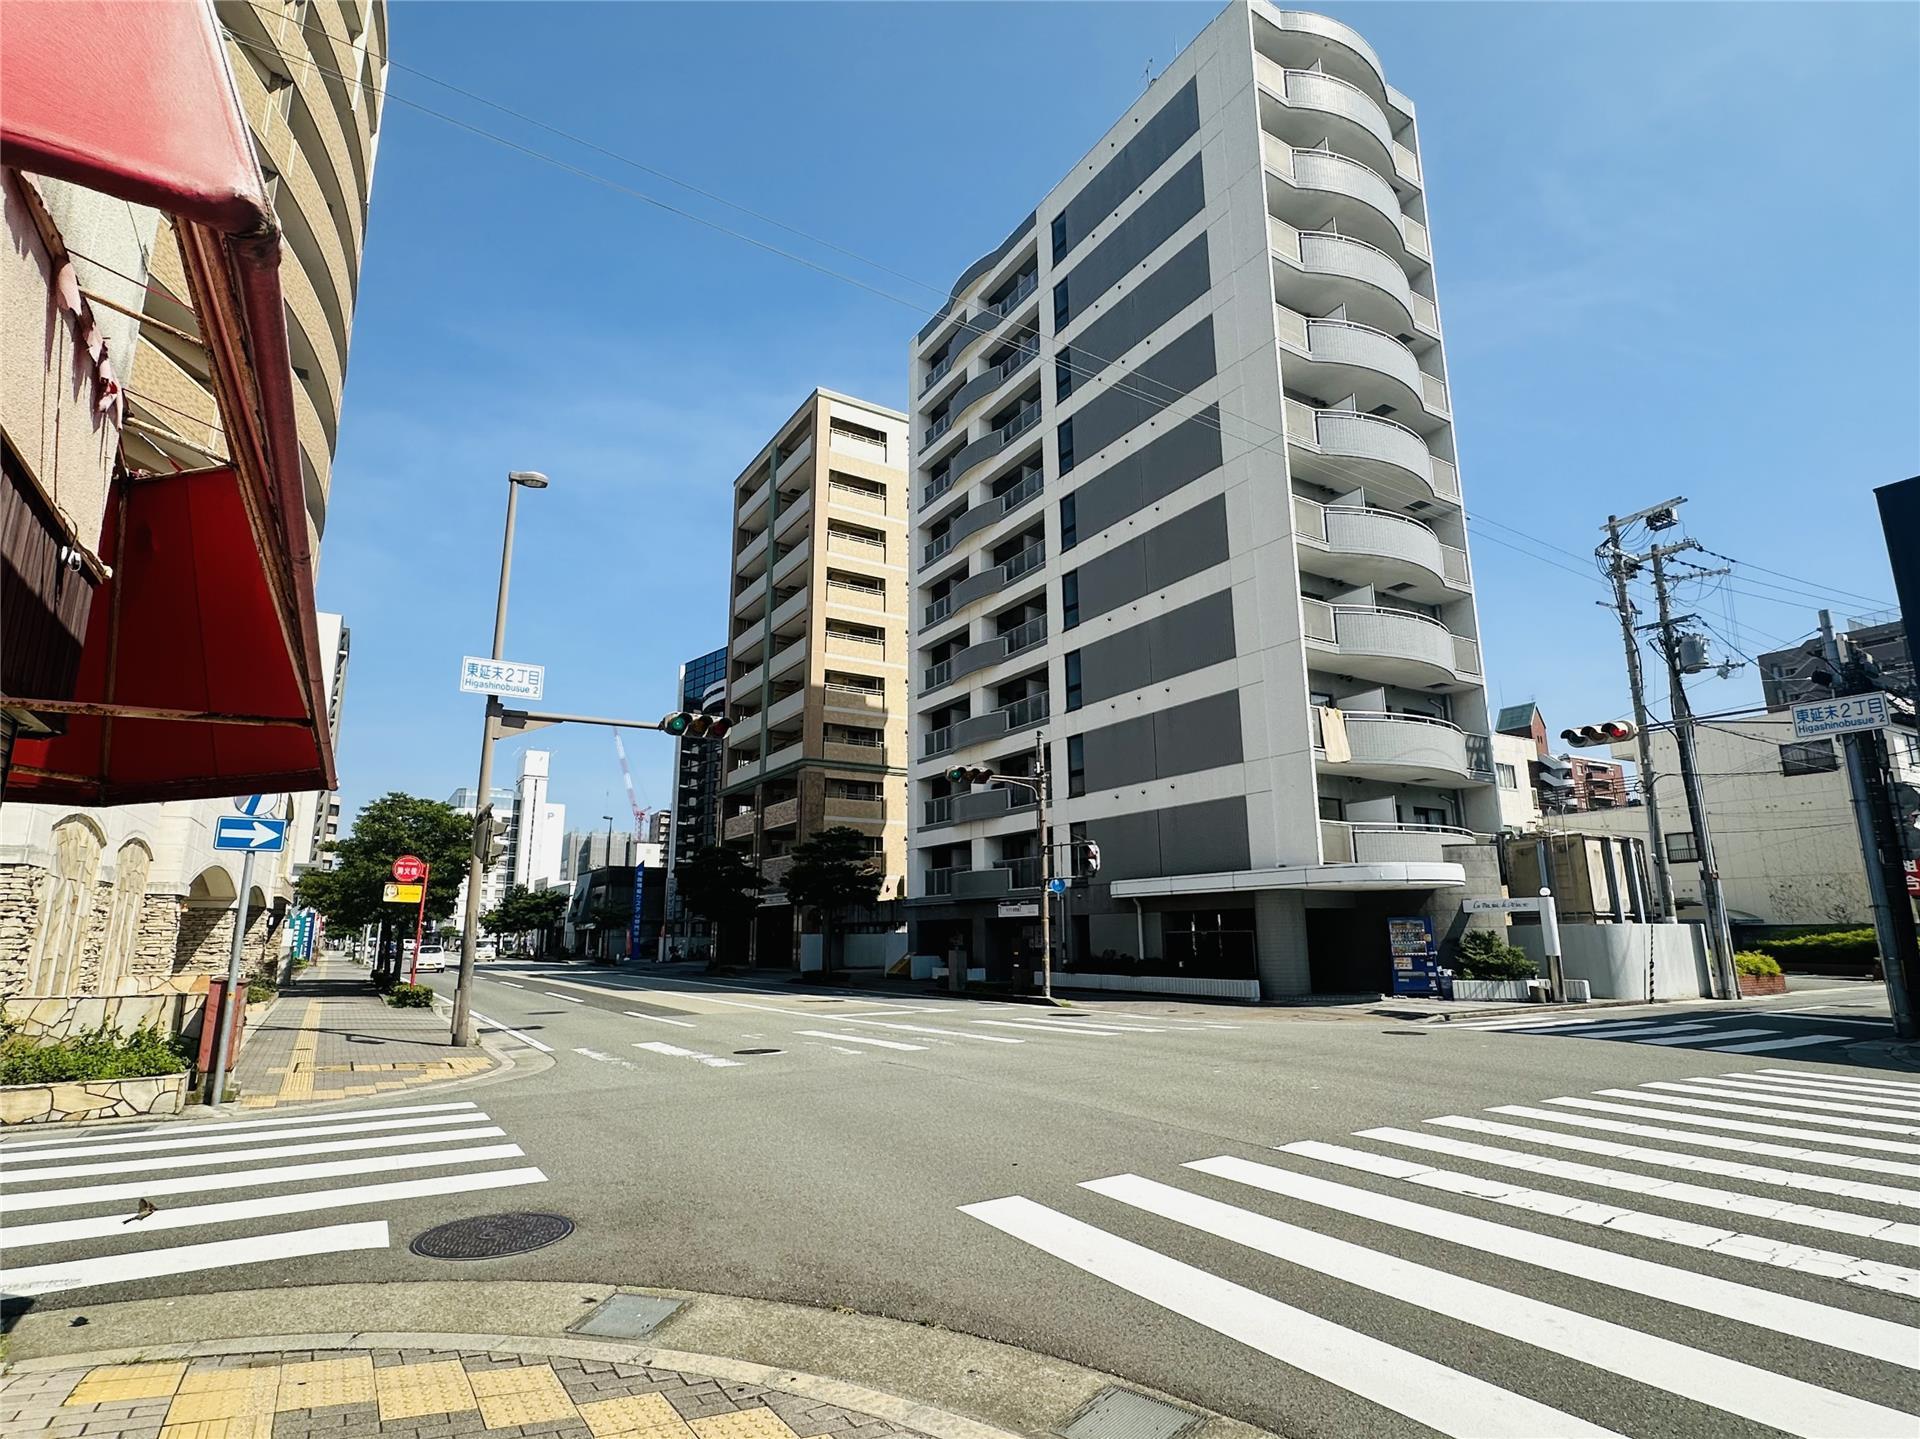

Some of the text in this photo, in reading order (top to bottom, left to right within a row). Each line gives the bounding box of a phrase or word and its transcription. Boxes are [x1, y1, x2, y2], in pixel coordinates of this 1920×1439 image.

[467, 663, 540, 685] 東延末2丁目
[465, 679, 539, 694] Higashinobusue 2
[1796, 698, 1883, 724] 東延末2丁目
[1798, 714, 1885, 733] Higashinobusue 2
[547, 812, 554, 820] P
